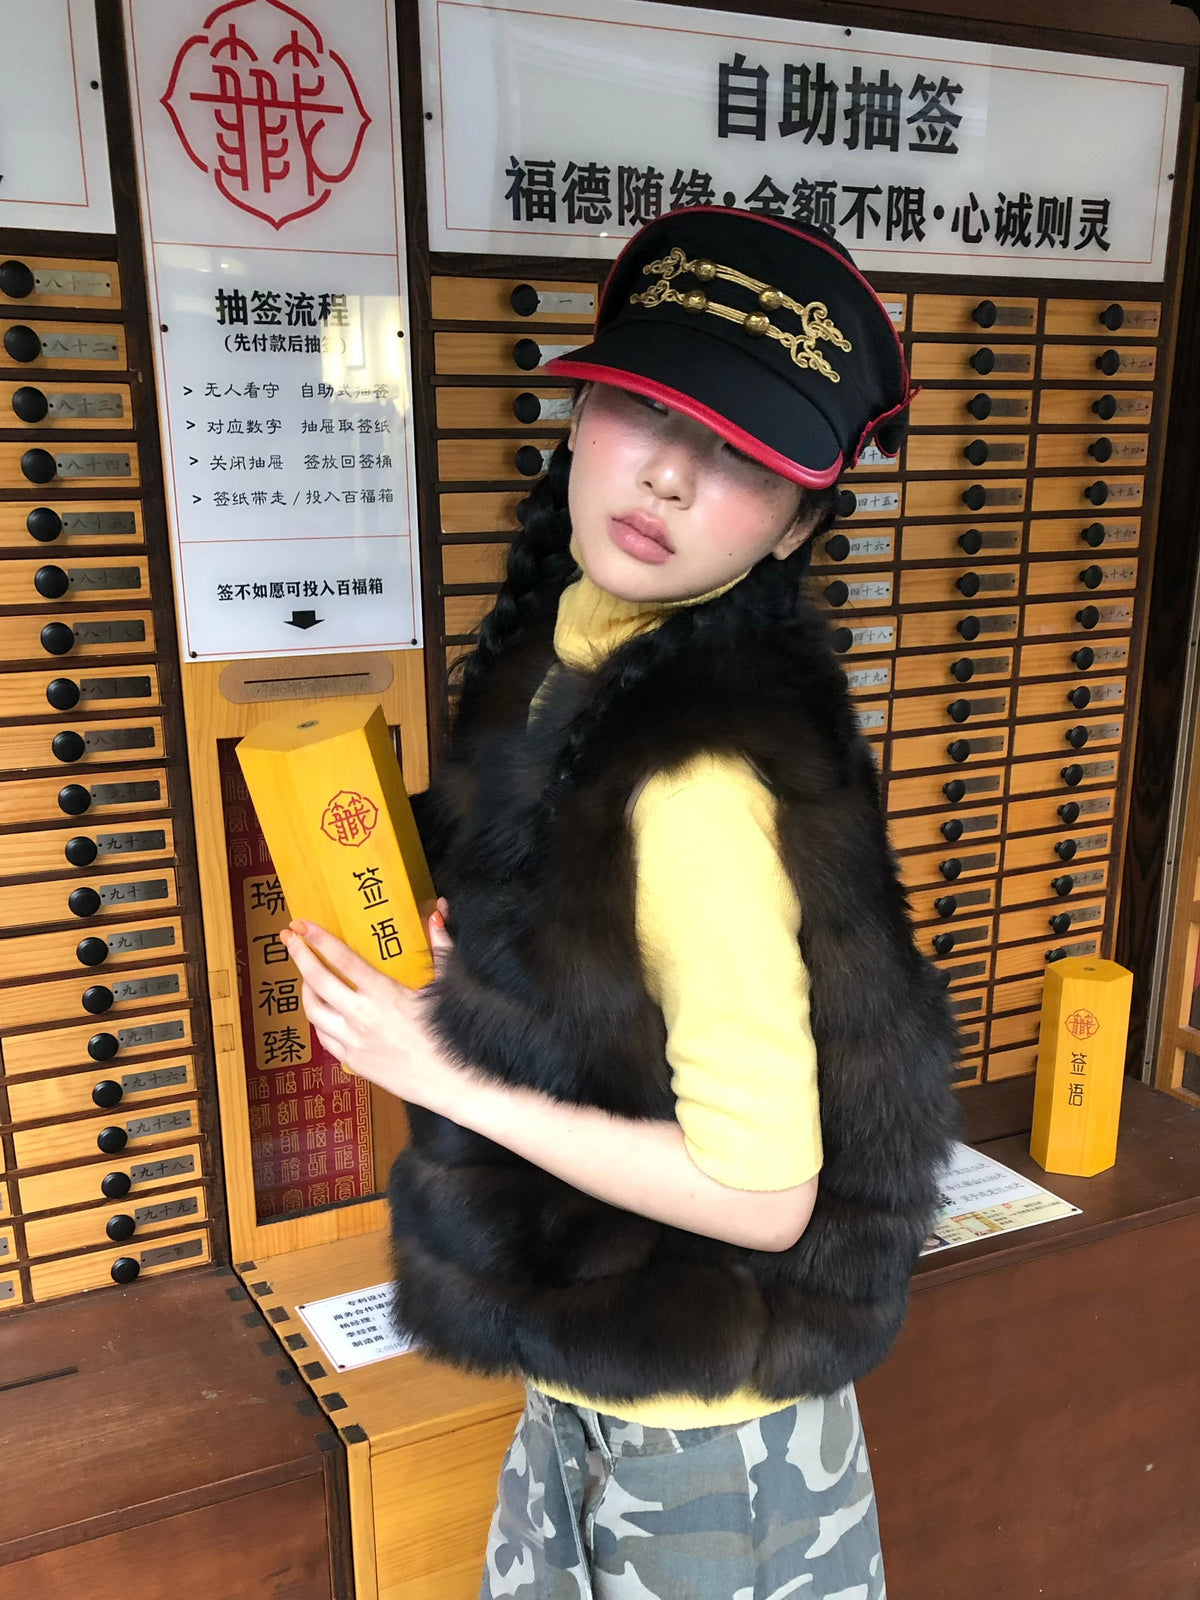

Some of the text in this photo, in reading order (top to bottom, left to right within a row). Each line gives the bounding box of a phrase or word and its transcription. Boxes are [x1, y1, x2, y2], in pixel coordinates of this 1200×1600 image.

[717, 52, 965, 155] 自助抽签
[45, 274, 102, 291] 八十一
[215, 288, 349, 327] 抽签流程
[52, 338, 110, 354] 八十二
[204, 382, 389, 399] 无人看守 自助式抽签
[57, 397, 114, 413] 八十三
[207, 419, 391, 434] 对应数字 抽屉取签纸
[66, 457, 120, 473] 八十四
[209, 454, 392, 470] 关闭抽屉 签放回签桶
[858, 495, 892, 507] 四十五
[851, 540, 885, 552] 四十六
[216, 578, 383, 601] 签不如愿可投入百福箱
[851, 585, 885, 597] 四十七
[854, 630, 887, 642] 四十八
[353, 867, 403, 961] 签语
[250, 875, 306, 1065] 瑞百福臻
[131, 1070, 179, 1089] 九十六
[1068, 1052, 1087, 1107] 签语
[136, 1115, 183, 1133] 九十七
[139, 1160, 187, 1178] 九十八
[143, 1202, 190, 1220] 九十九
[347, 1292, 390, 1307] 专利设计
